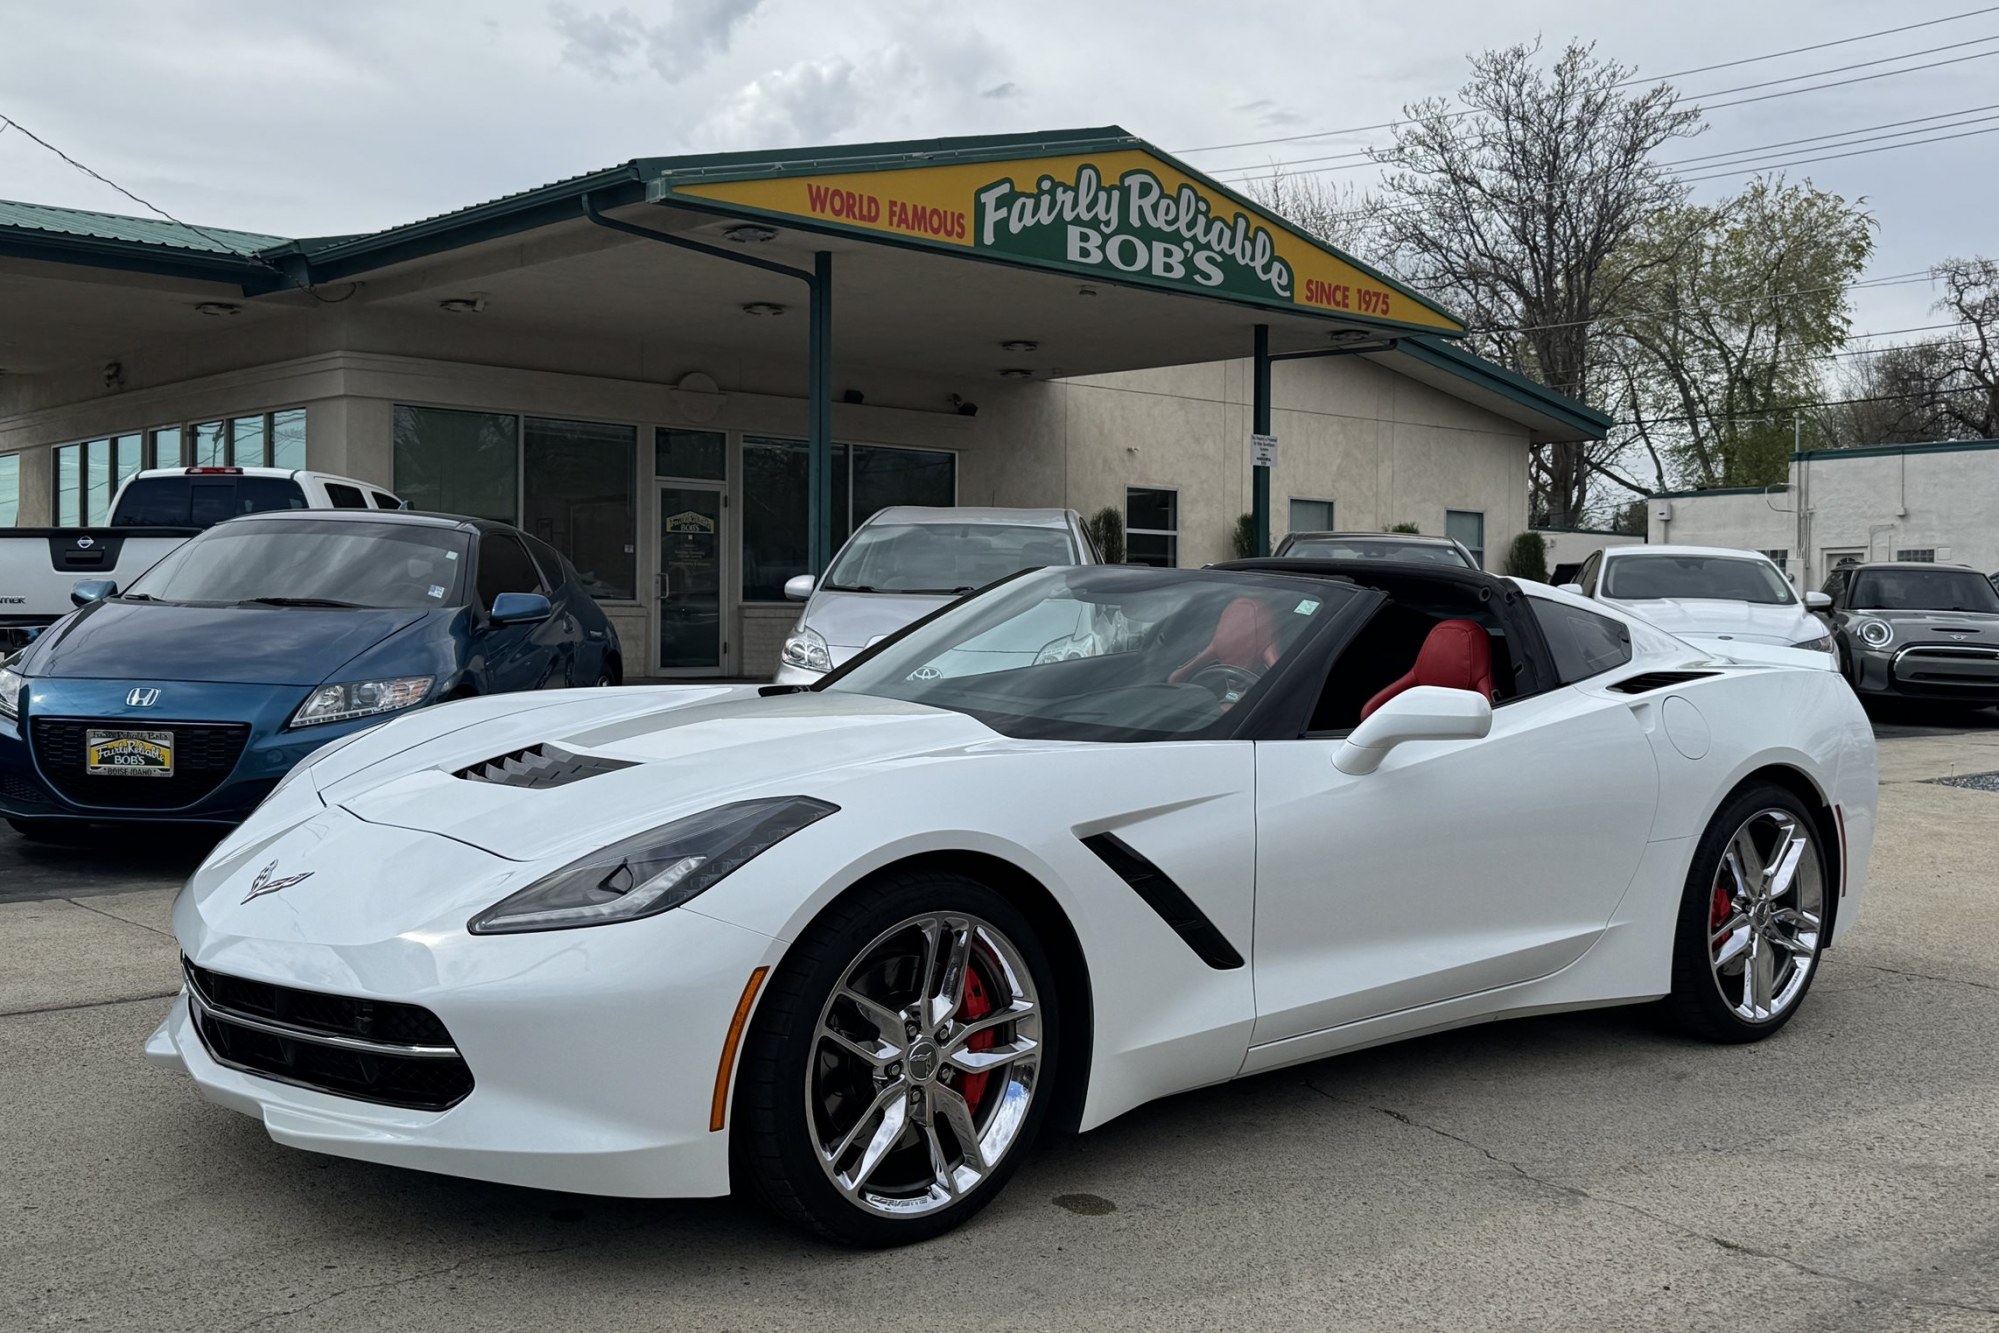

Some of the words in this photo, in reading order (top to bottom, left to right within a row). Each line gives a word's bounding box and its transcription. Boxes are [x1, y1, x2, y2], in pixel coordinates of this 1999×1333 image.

[807, 183, 881, 224] WORLD
[888, 199, 967, 240] FAMOUS
[980, 167, 1121, 247] Fairly
[1123, 173, 1291, 297] Reliable
[1066, 224, 1225, 287] BOB'S
[1305, 278, 1350, 309] SINCE
[1356, 287, 1390, 316] 1975
[97, 742, 128, 760] Fairly
[125, 740, 165, 763] Reliable
[114, 754, 145, 766] BOB'S
